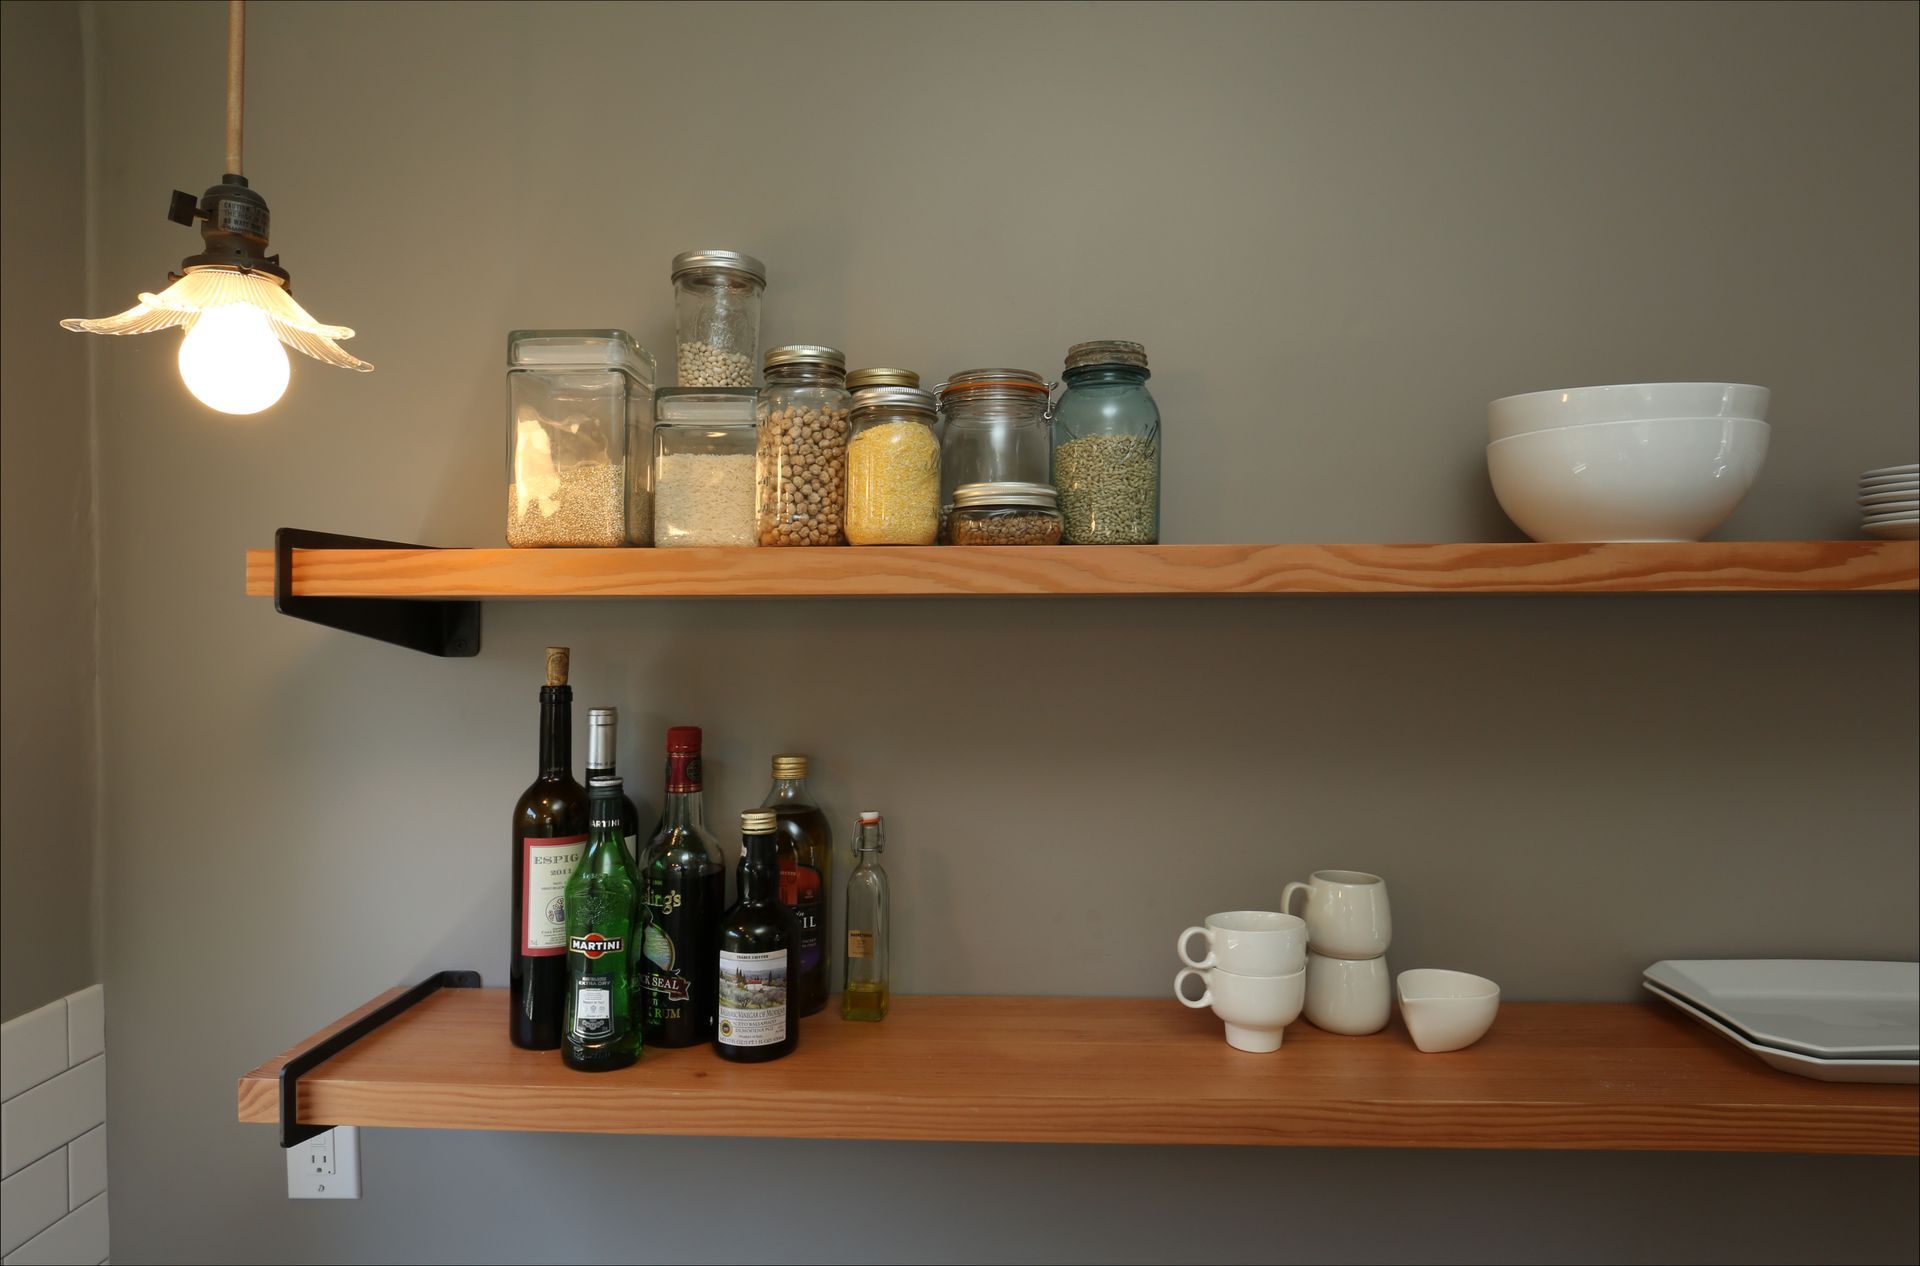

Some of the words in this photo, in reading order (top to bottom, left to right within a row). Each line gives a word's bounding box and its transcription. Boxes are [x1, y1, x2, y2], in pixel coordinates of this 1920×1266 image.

[592, 819, 620, 828] ARTINI
[533, 854, 579, 865] ESPIG
[550, 868, 572, 876] 2011
[799, 916, 816, 929] IL
[572, 939, 620, 951] MARTINI
[651, 977, 680, 990] SEAL
